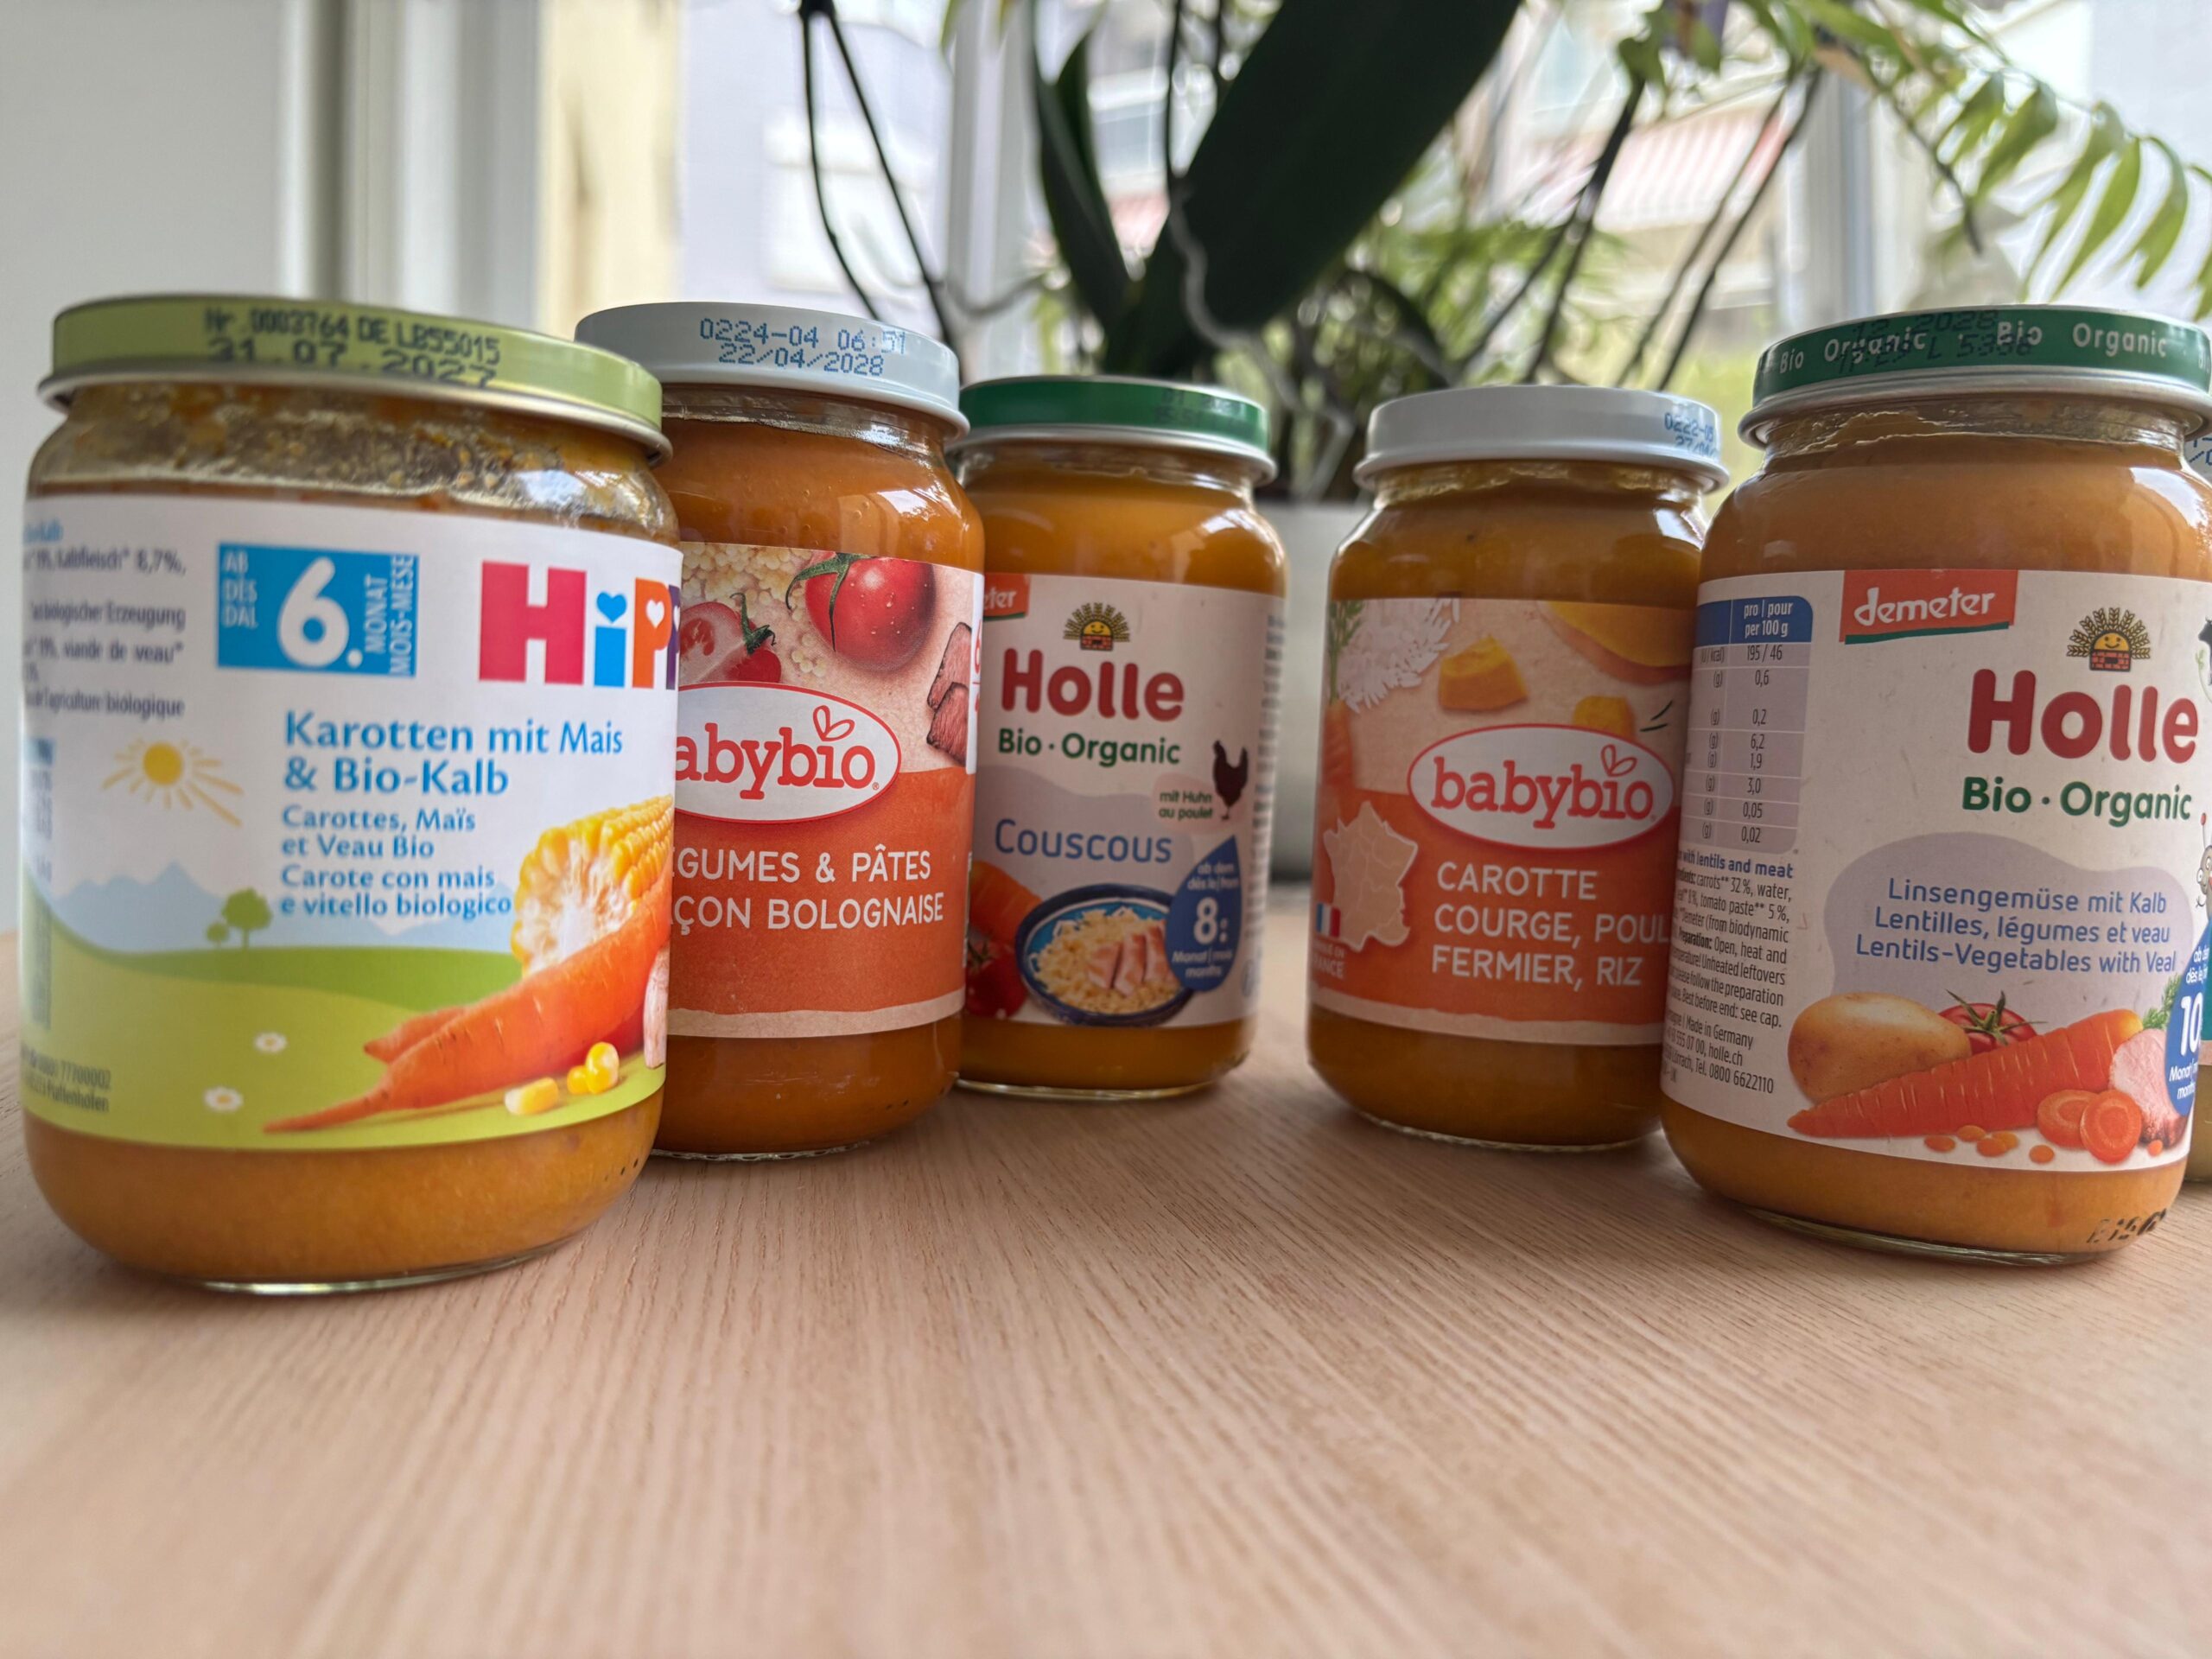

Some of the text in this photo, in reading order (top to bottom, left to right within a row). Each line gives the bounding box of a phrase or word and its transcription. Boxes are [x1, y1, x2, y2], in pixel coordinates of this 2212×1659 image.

[357, 315, 390, 345] DE
[700, 318, 819, 348] 0224-04
[718, 342, 884, 377] 22/04/2028
[1780, 349, 1804, 374] Bio
[1824, 326, 1927, 365] Organic
[1996, 320, 2044, 346] Bio
[2072, 322, 2166, 358] Organic
[225, 550, 249, 574] AB
[223, 575, 258, 602] DÈS
[223, 604, 259, 629] DAL
[364, 573, 388, 654] MONAT
[390, 554, 414, 677] MOIS-MESE
[1744, 602, 1794, 619] pro pour
[1853, 587, 1995, 627] demeter
[1745, 620, 1788, 639] per 100 g
[1747, 645, 1760, 660] 195
[1770, 645, 1783, 660] 46
[1001, 648, 1185, 721] Holle
[1755, 670, 1770, 687] 0,6
[1752, 709, 1767, 726] 0,2
[1967, 668, 2198, 764] Holle
[285, 709, 623, 754] Karotten mit Mais
[1751, 734, 1764, 751] 6,2
[676, 722, 875, 799] abybio
[998, 728, 1181, 767] Bio Organic
[1751, 753, 1763, 770] 1,9
[284, 757, 509, 795] & Bio-Kalb
[1747, 778, 1761, 795] 3,0
[1160, 791, 1212, 804] mit Huhn
[1431, 756, 1654, 830] babybio
[1962, 776, 2192, 828] Bio Organic
[283, 804, 476, 831] Carottes, Maïs
[1159, 806, 1213, 820] au poulet
[1743, 802, 1763, 819] 0,05
[282, 835, 435, 858] et Veau Bio
[995, 818, 1173, 863] Couscous
[1741, 826, 1761, 843] 0,02
[282, 865, 495, 889] Carote con mais
[673, 844, 931, 883] GUMES & PÂTES
[1697, 852, 1725, 869] lentils
[1728, 859, 1751, 873] and
[1755, 862, 1794, 878] meat
[1437, 861, 1599, 900] CAROTTE
[1730, 877, 1740, 893] 32
[1758, 883, 1791, 902] water,
[282, 893, 512, 920] e vitello biologico
[1700, 893, 1726, 911] tomato
[1888, 878, 2166, 914] Linsengemüse mit Kalb
[671, 892, 944, 935] ÇON BOLOGNAISE
[1434, 903, 1669, 949] COURGE, POUL
[1706, 914, 1726, 931] (from
[1729, 918, 1789, 943] biodynamic
[1875, 906, 2171, 944] Lentilles, légumes et veau
[1714, 937, 1738, 957] Open,
[1741, 941, 1763, 960] heat
[1766, 949, 1787, 964] and
[1856, 934, 2176, 973] Lentils-Vegetables with Veal
[1432, 944, 1582, 991] FERMIER,
[1597, 956, 1643, 985] RIZ
[1701, 954, 1739, 976] Unheated
[1740, 962, 1785, 985] leftovers
[1690, 970, 1710, 990] follow
[1711, 977, 1724, 994] the
[1725, 983, 1784, 1007] preparation
[1695, 992, 1718, 1013] before
[1719, 1002, 1738, 1019] end:
[1740, 1007, 1758, 1023] see
[1760, 1012, 1782, 1029] cap.
[1687, 1015, 1703, 1034] Made
[1704, 1020, 1711, 1037] in
[1713, 1025, 1754, 1051] Germany
[1709, 1042, 1743, 1066] holle.ch
[1695, 1058, 1707, 1076] Tel.
[1709, 1063, 1731, 1084] 0800
[1733, 1071, 1774, 1094] 6622110
